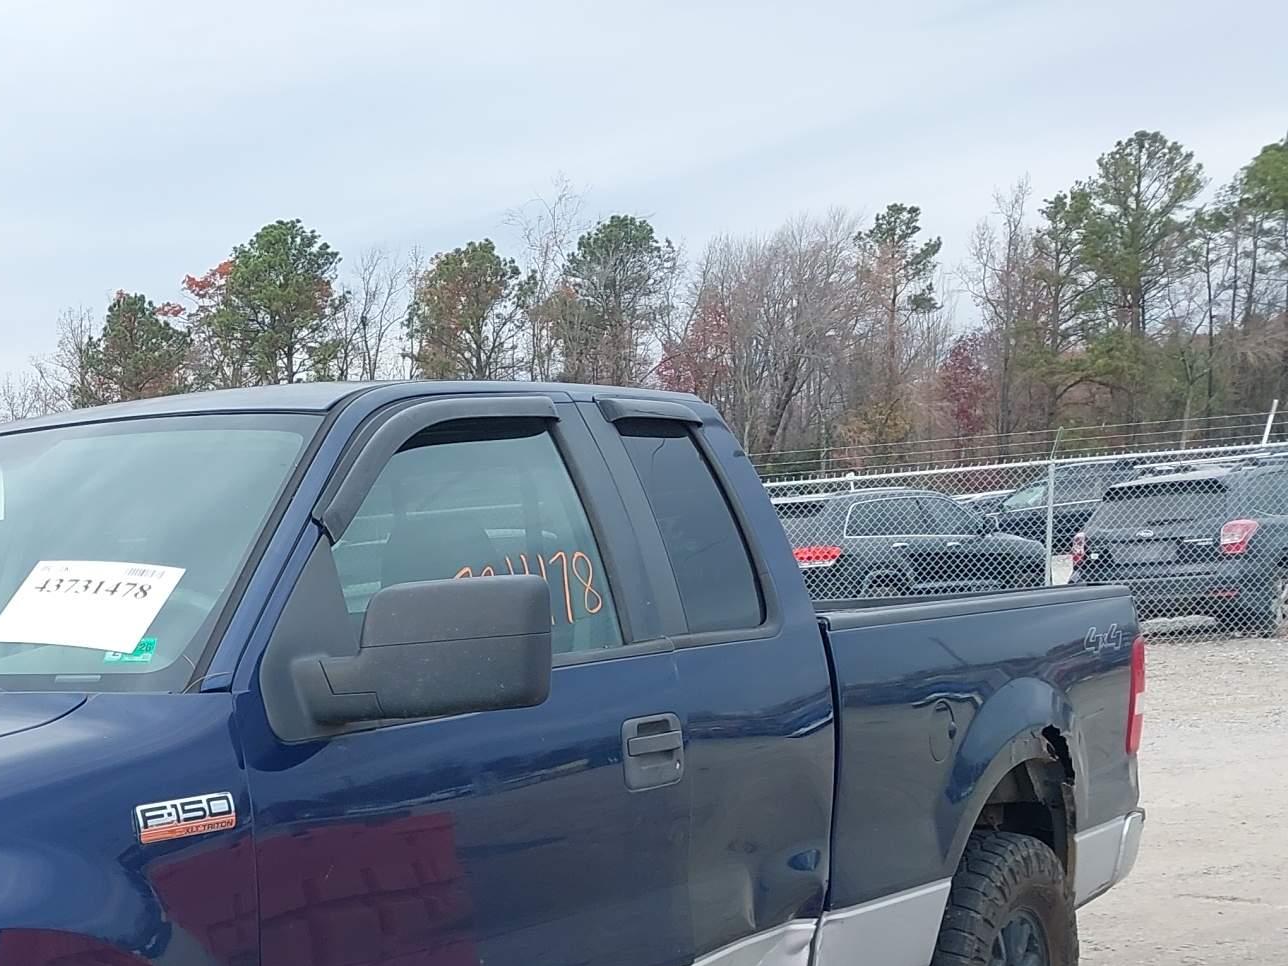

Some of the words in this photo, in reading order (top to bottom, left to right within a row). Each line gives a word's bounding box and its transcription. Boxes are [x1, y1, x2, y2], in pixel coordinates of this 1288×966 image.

[34, 577, 153, 600] 43731478
[1083, 623, 1122, 653] 4x4
[139, 795, 232, 829] F-150
[184, 825, 200, 835] XLT
[201, 818, 234, 832] TRITON
